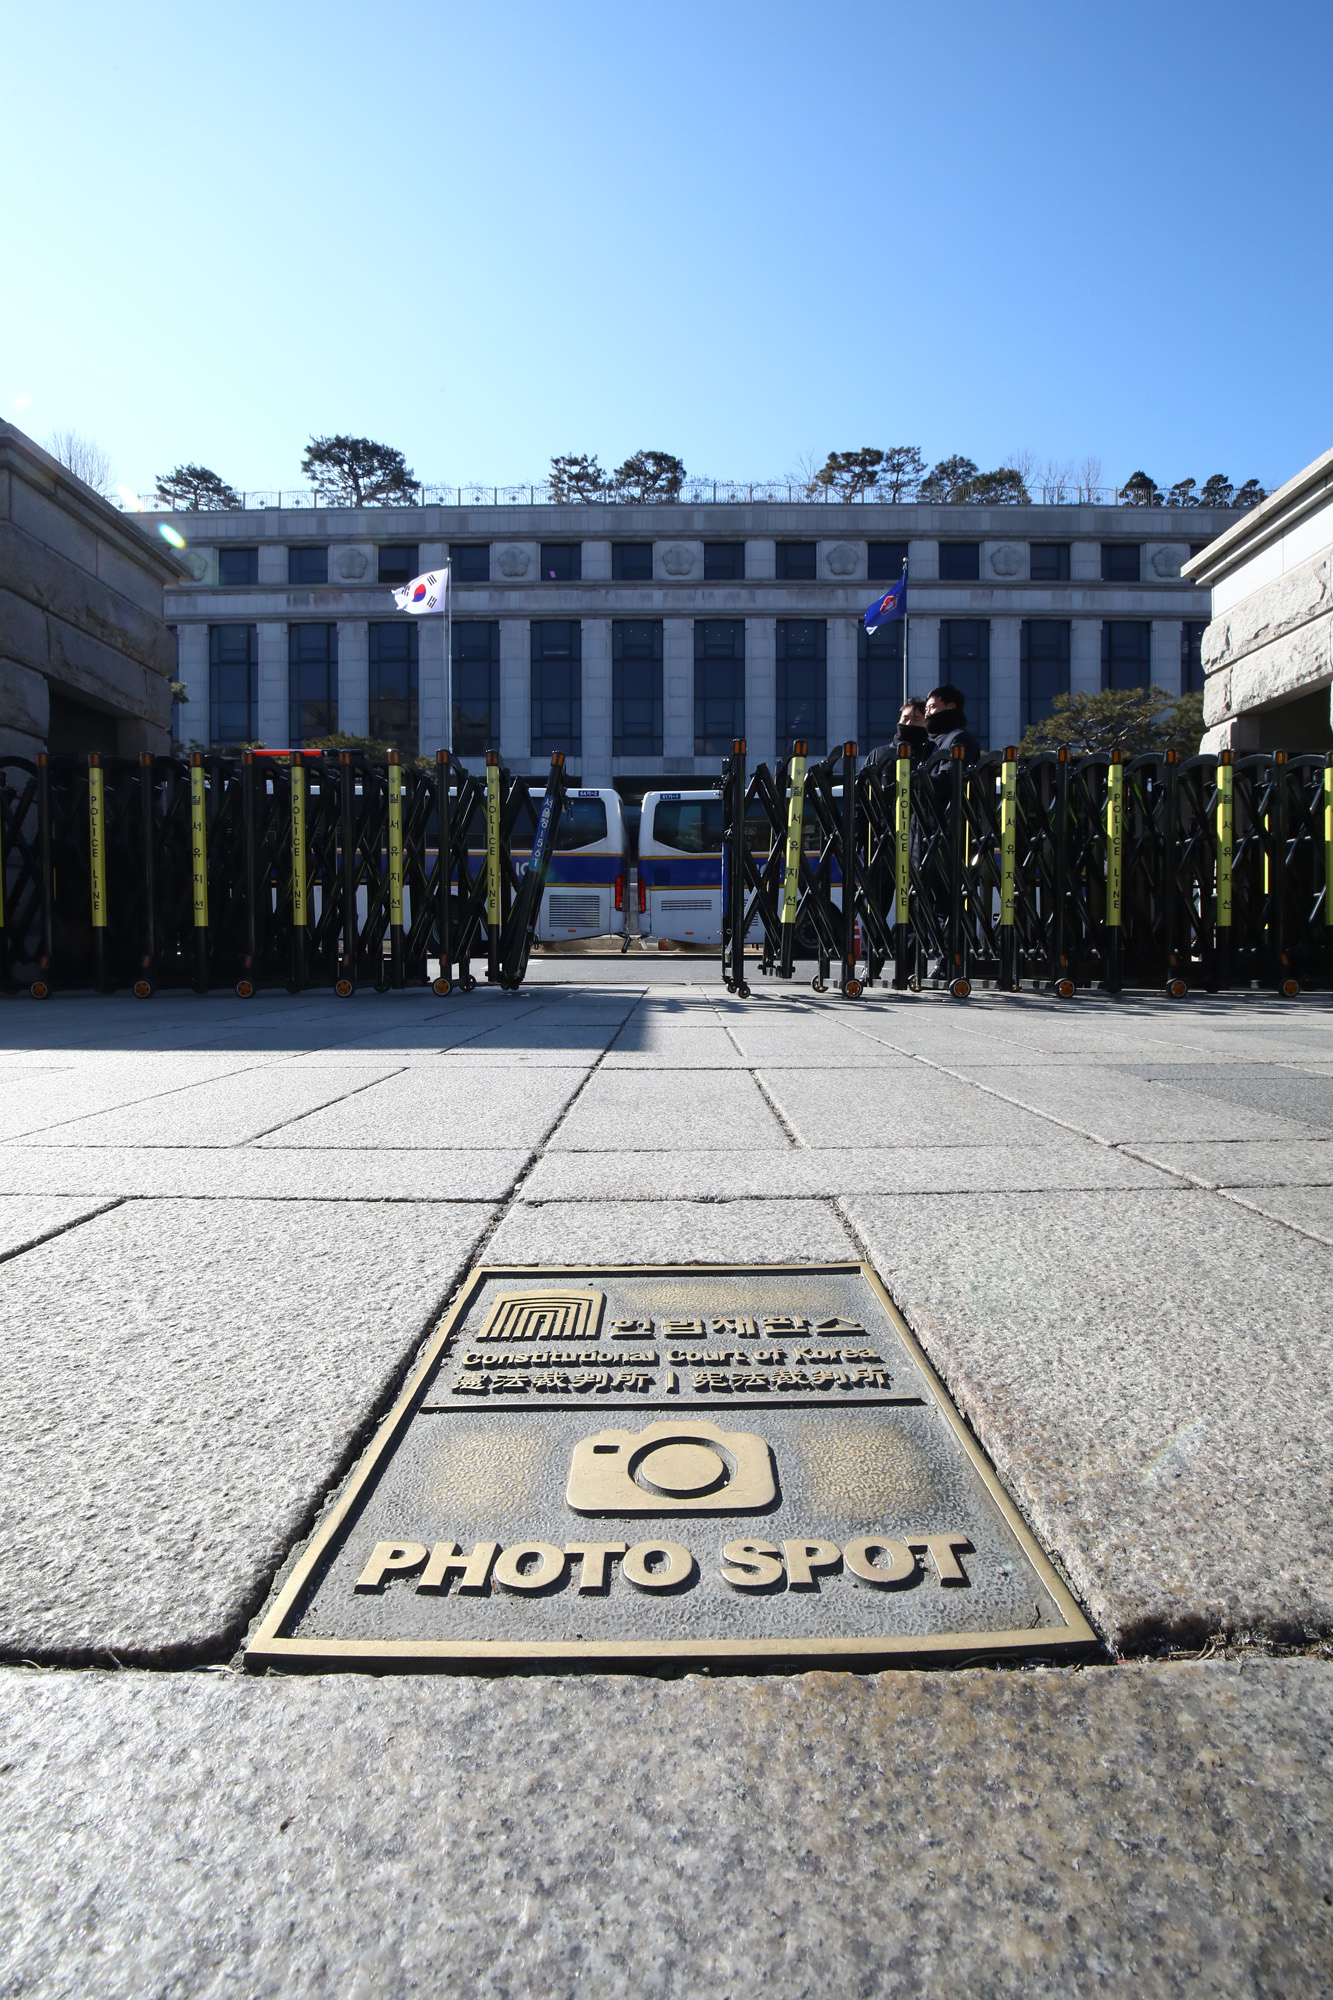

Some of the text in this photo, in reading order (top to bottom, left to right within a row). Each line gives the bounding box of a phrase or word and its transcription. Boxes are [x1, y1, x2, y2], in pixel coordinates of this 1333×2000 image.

[292, 795, 301, 857] POLICE
[389, 793, 400, 909] 질서유지선
[488, 794, 497, 856] POLICE
[785, 786, 803, 906] 질서유지선
[900, 788, 908, 852] POLICE
[1112, 793, 1121, 856] POLICE
[90, 795, 100, 910] POLICE LINE
[191, 795, 204, 910] 질서유지선
[463, 1346, 880, 1368] Constitutional Court of Korea
[611, 1316, 866, 1339] 헌법재판소
[355, 1532, 973, 1595] PHOTO SPOT
